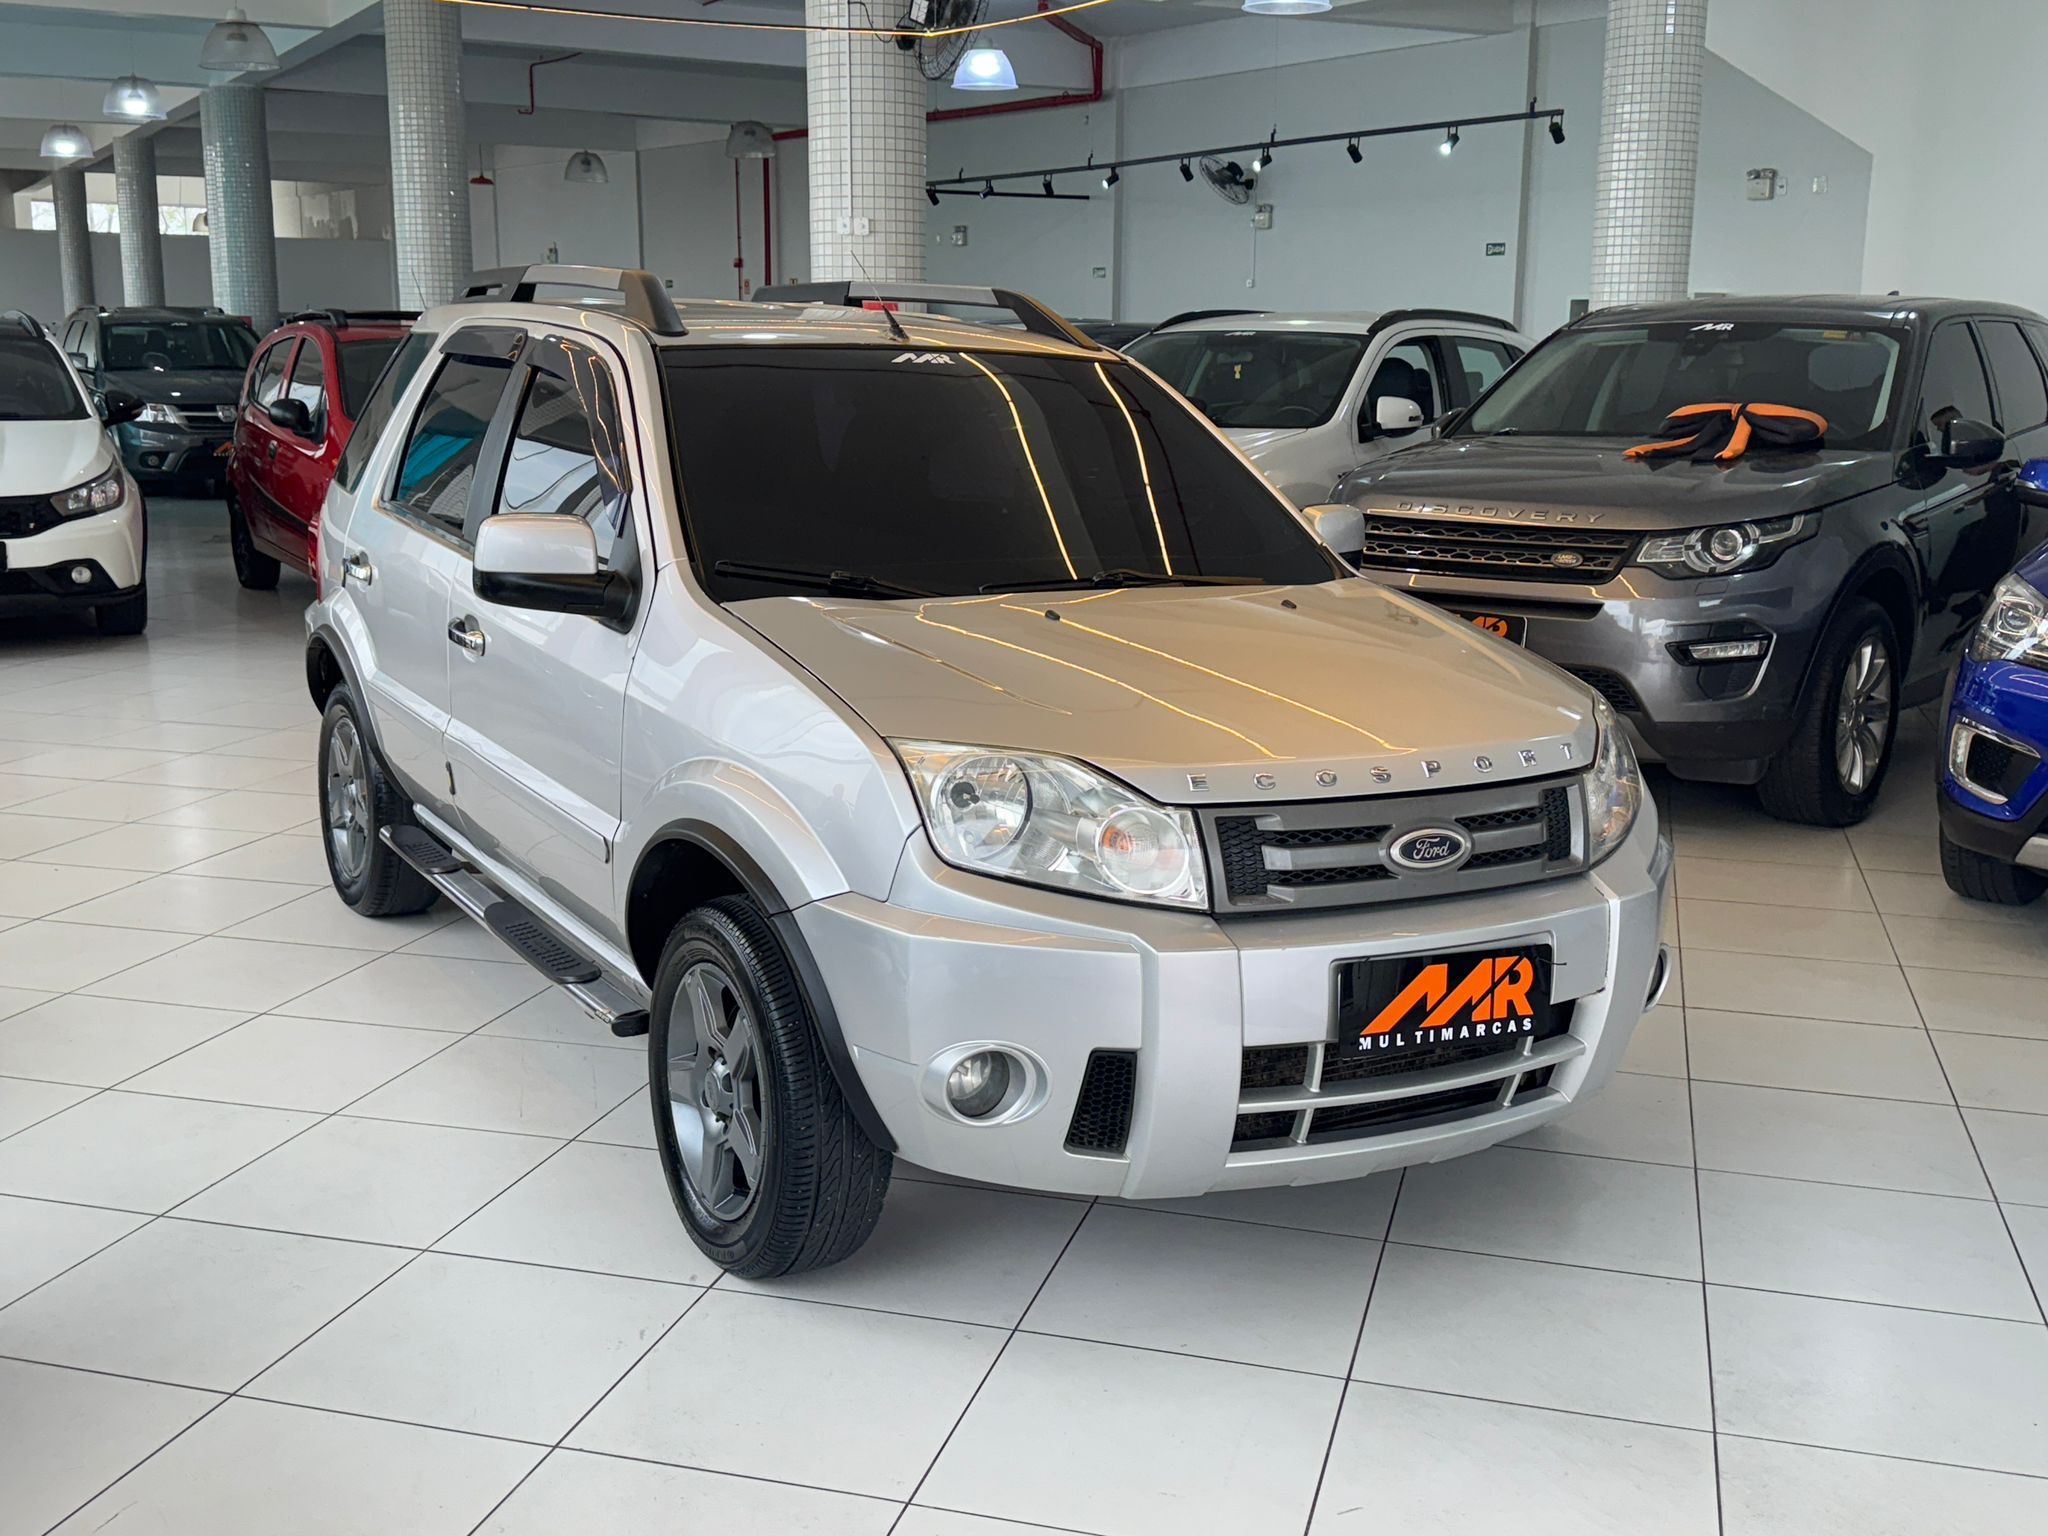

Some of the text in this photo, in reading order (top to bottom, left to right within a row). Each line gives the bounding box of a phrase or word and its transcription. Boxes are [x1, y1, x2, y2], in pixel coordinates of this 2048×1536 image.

[1396, 502, 1605, 524] DISCOVERY
[1187, 742, 1572, 793] ECOSPORT
[1412, 836, 1451, 860] Ford
[1359, 1017, 1533, 1051] MULTIMARCAS
